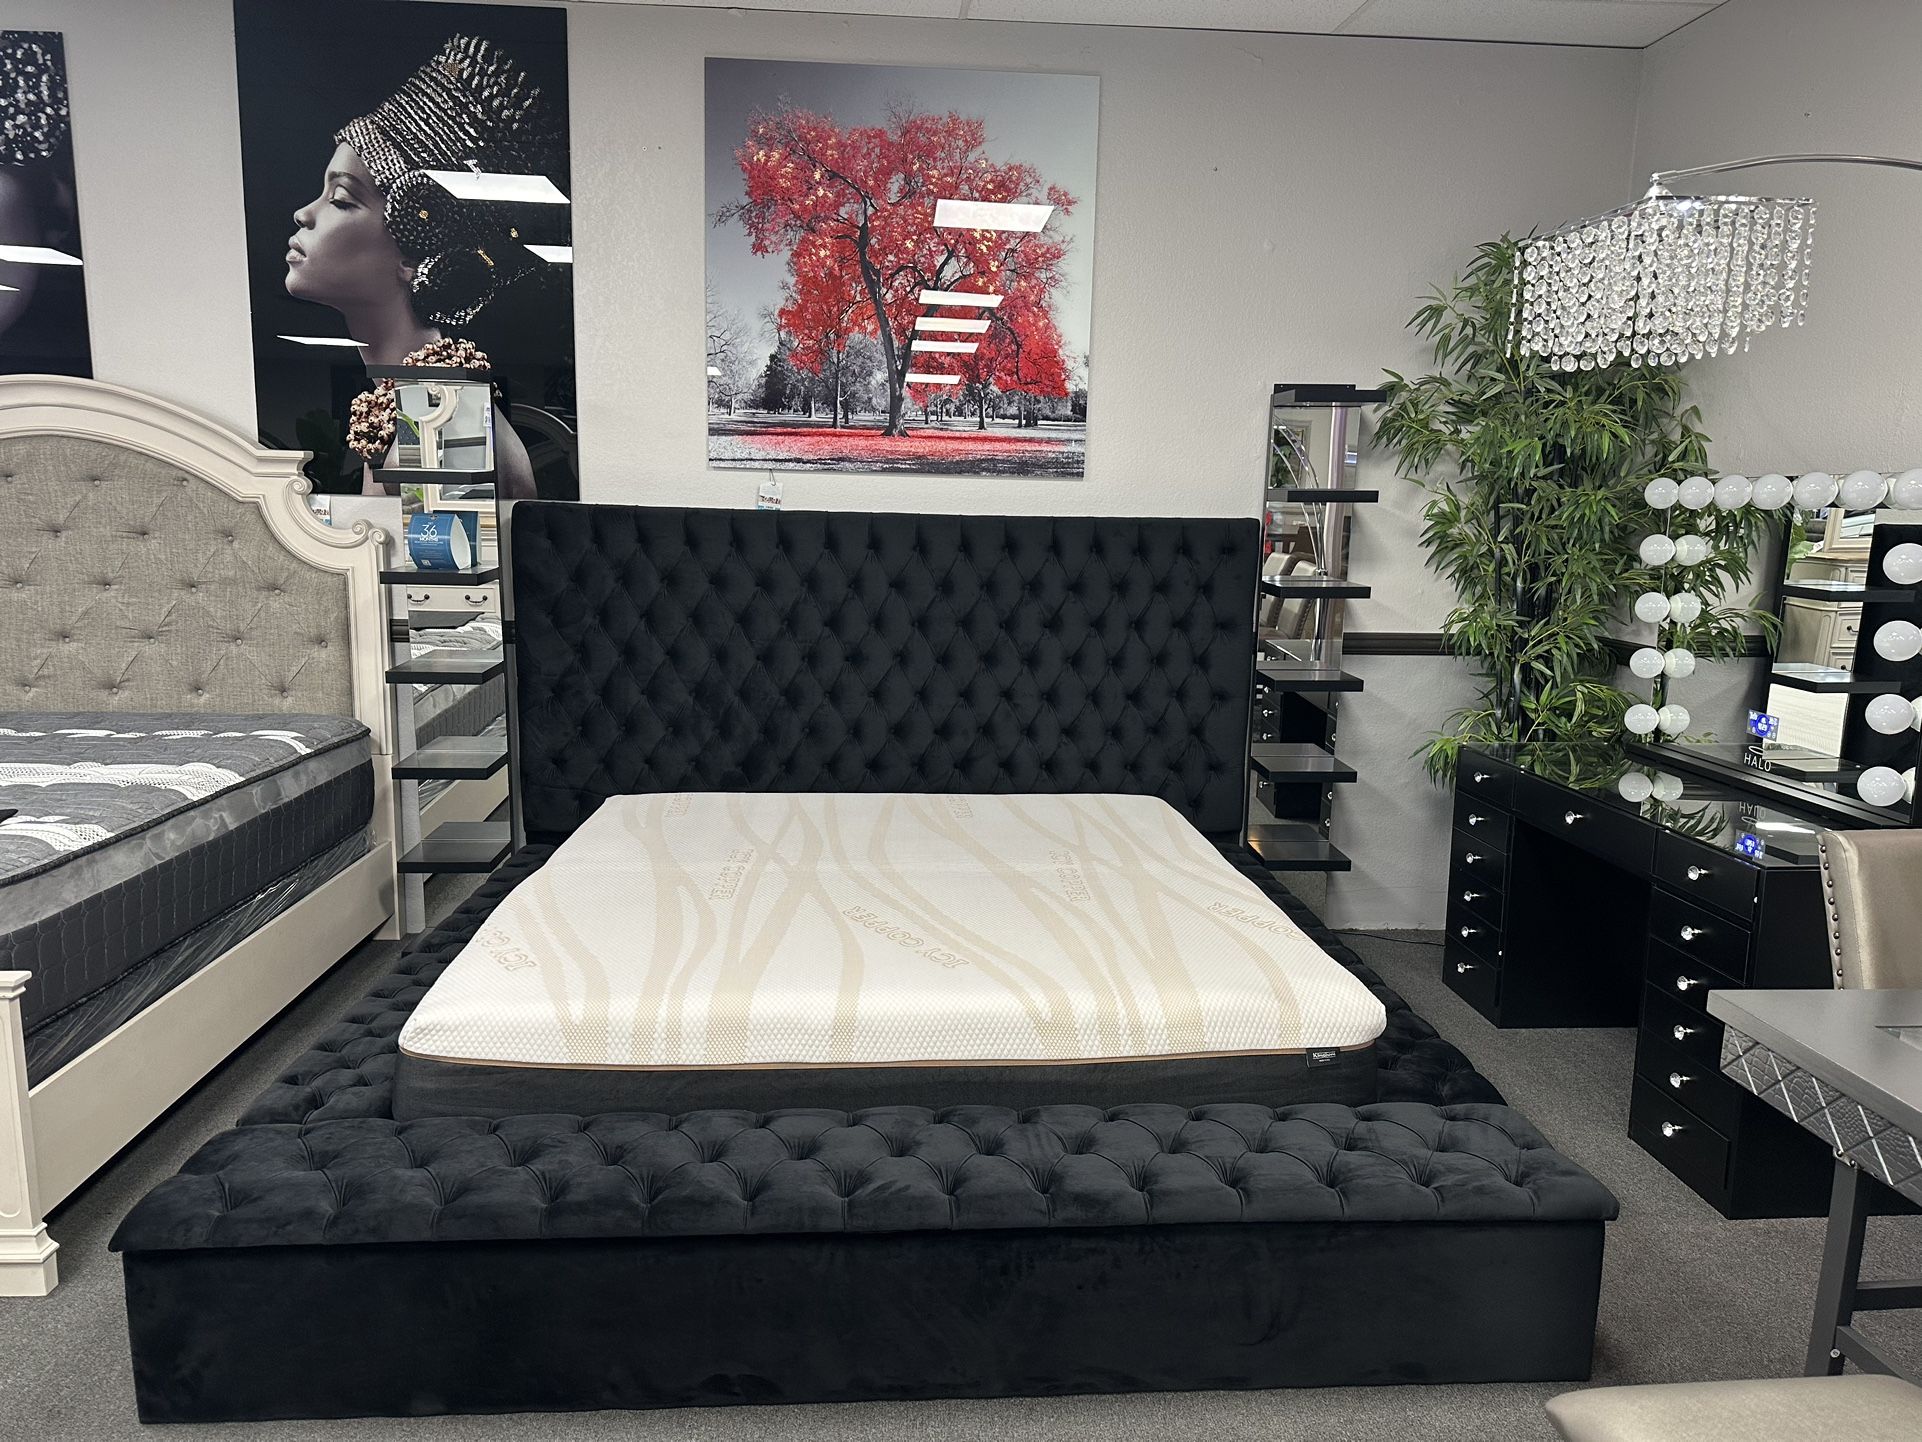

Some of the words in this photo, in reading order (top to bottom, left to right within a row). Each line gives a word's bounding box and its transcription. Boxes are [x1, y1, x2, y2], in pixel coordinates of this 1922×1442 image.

[421, 524, 438, 538] 36
[1743, 752, 1771, 772] HALO
[708, 865, 746, 900] COPPER
[1056, 867, 1091, 902] COPPER
[842, 905, 925, 947] COPPER
[915, 948, 970, 968] ICY
